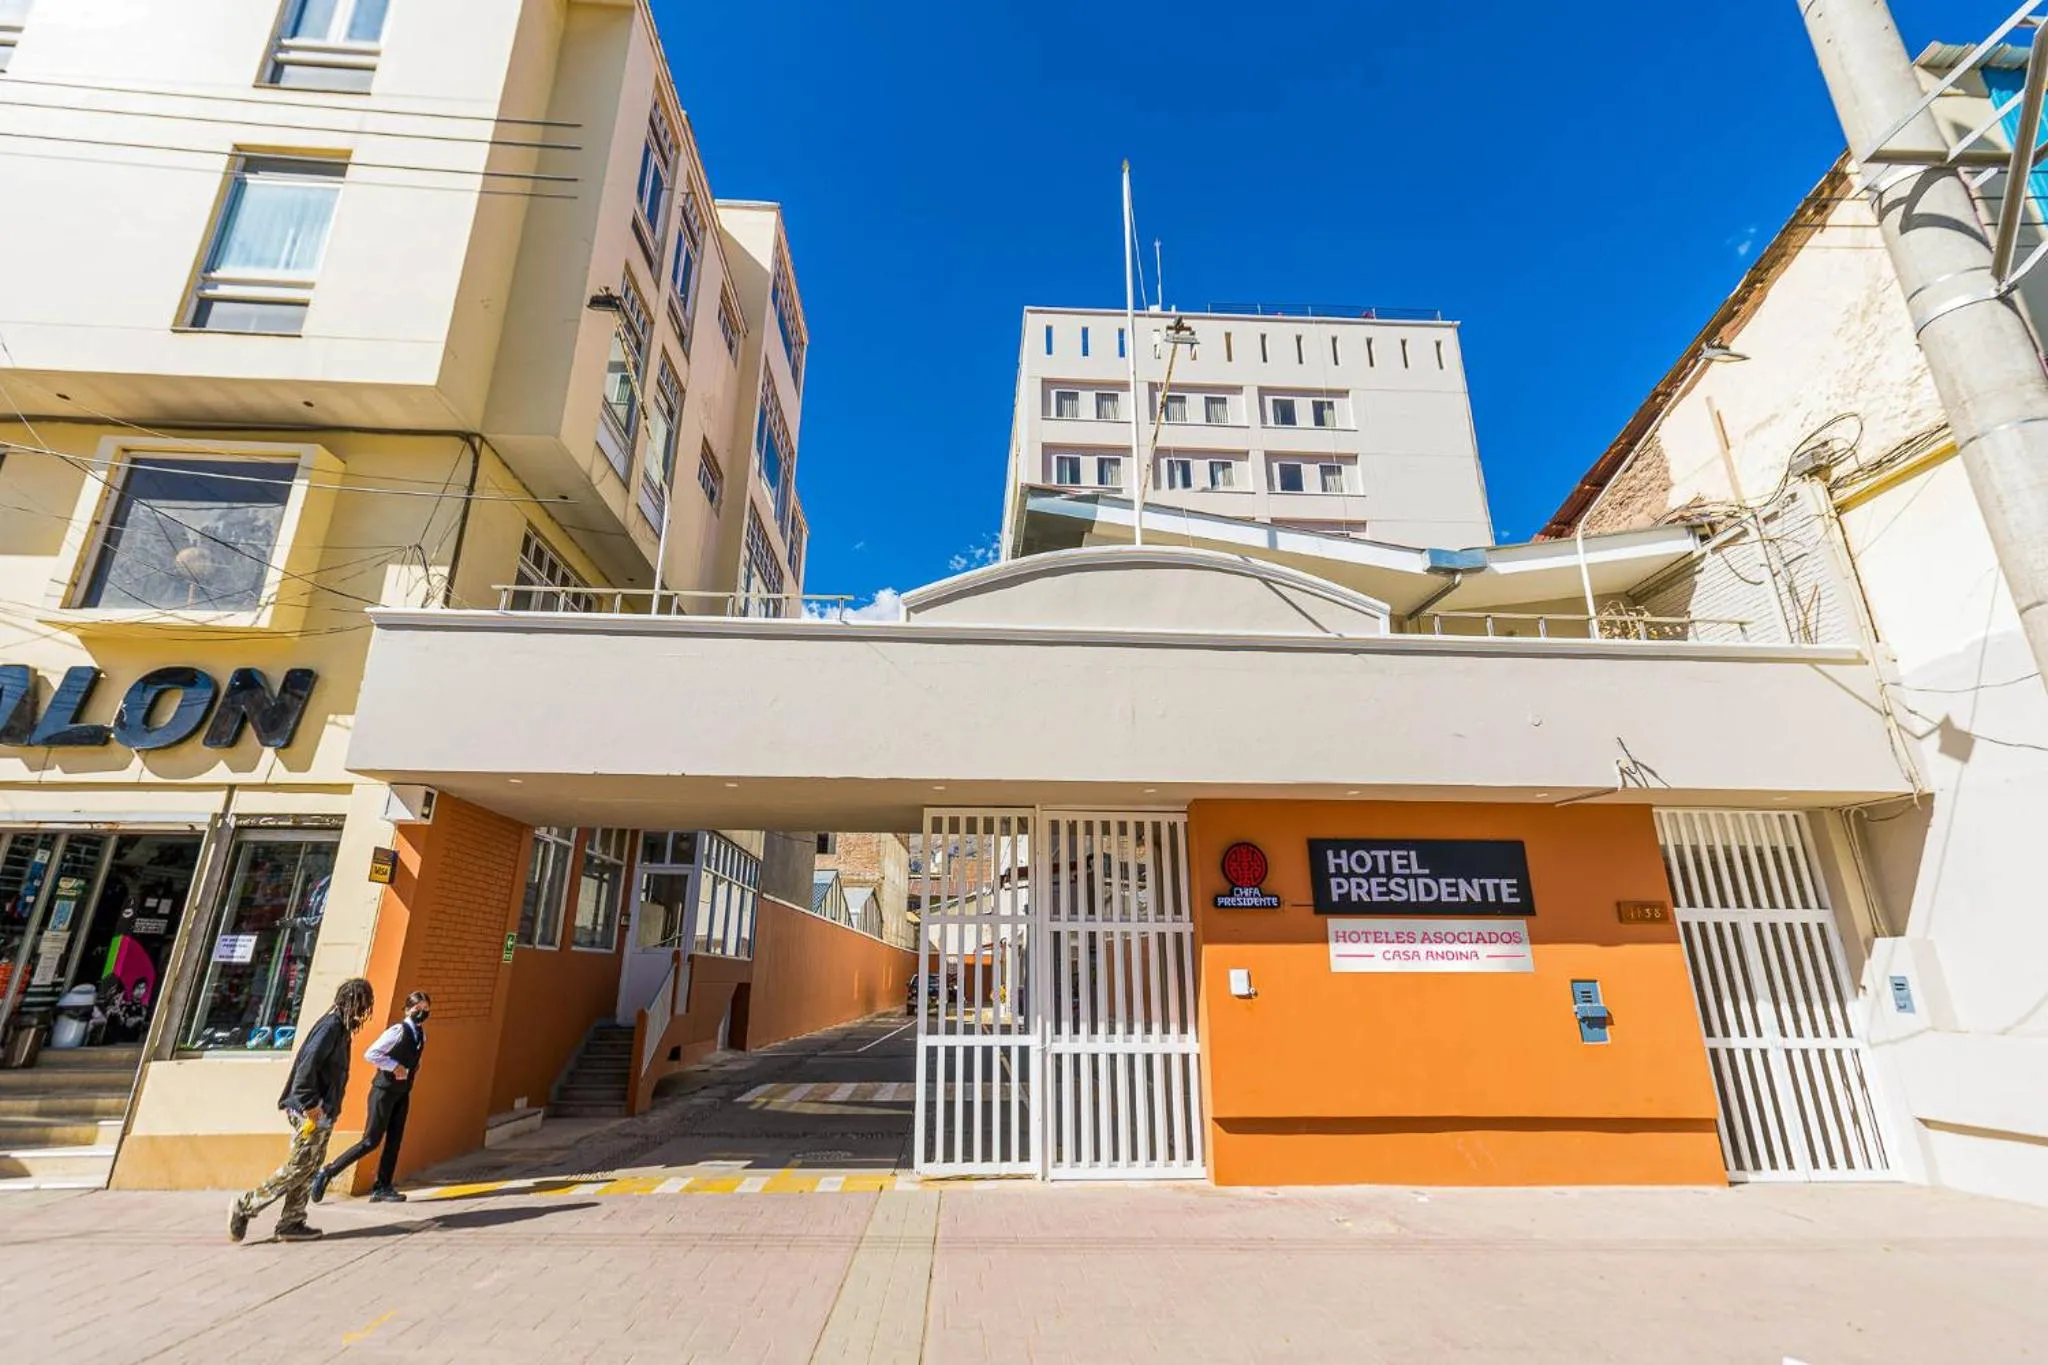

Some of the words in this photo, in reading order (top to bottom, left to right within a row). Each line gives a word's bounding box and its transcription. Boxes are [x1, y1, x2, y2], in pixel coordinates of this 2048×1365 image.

[1327, 850, 1430, 874] HOTEL
[1233, 887, 1260, 897] CHIFA
[1330, 878, 1521, 903] PRESIDENTE
[1217, 896, 1278, 906] PRESIDENTE
[1334, 931, 1416, 944] HOTELES
[1420, 931, 1522, 944] ASOCIADOS
[1382, 950, 1421, 961] CASA
[1425, 950, 1480, 961] ANDINA
